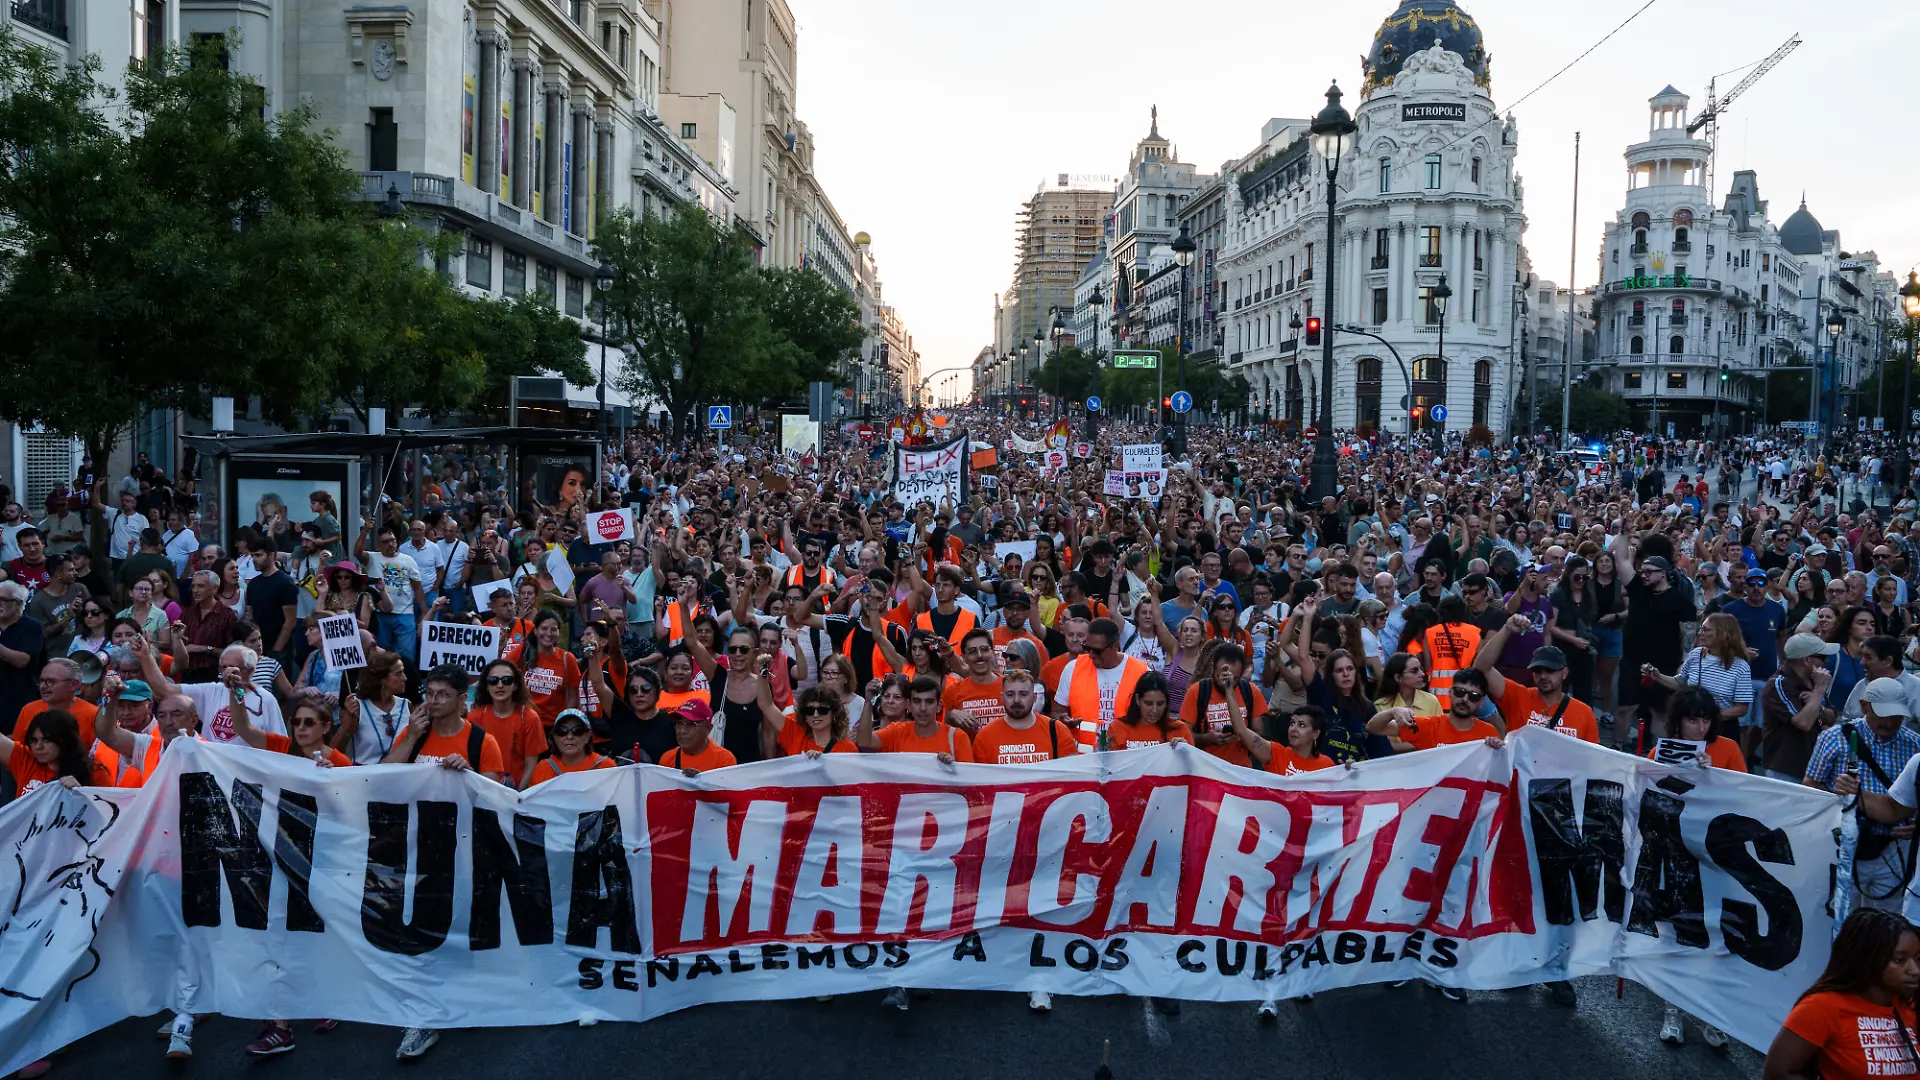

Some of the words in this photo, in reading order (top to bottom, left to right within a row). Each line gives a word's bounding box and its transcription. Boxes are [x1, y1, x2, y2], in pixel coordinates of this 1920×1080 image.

[1405, 106, 1463, 117] METROPOLIS
[1624, 274, 1693, 289] ROLEX
[1124, 445, 1160, 456] CULPABLES
[905, 443, 961, 473] ELIX
[598, 517, 622, 528] STOP
[322, 617, 355, 640] DERECHO
[428, 624, 492, 648] DERECHO
[428, 651, 438, 668] A
[962, 699, 998, 708] SINDICATO
[216, 714, 232, 728] STO
[999, 744, 1035, 753] SINDICATO
[1000, 756, 1008, 764] DE
[1010, 754, 1048, 764] INQUILINAS
[179, 772, 326, 933] NI
[360, 800, 642, 957] UNA
[680, 781, 1508, 943] MARICARMEN
[1528, 775, 1803, 972] MÁS
[578, 939, 910, 991] SEÑALEMOS
[952, 930, 987, 962] A
[1028, 932, 1130, 972] LOS
[1176, 930, 1459, 981] CULPABLES
[1857, 1016, 1899, 1030] SINDICA
[1862, 1034, 1875, 1045] DE
[1865, 1048, 1873, 1061] E
[1867, 1062, 1881, 1075] DE
[1883, 1062, 1917, 1075] MADRID
